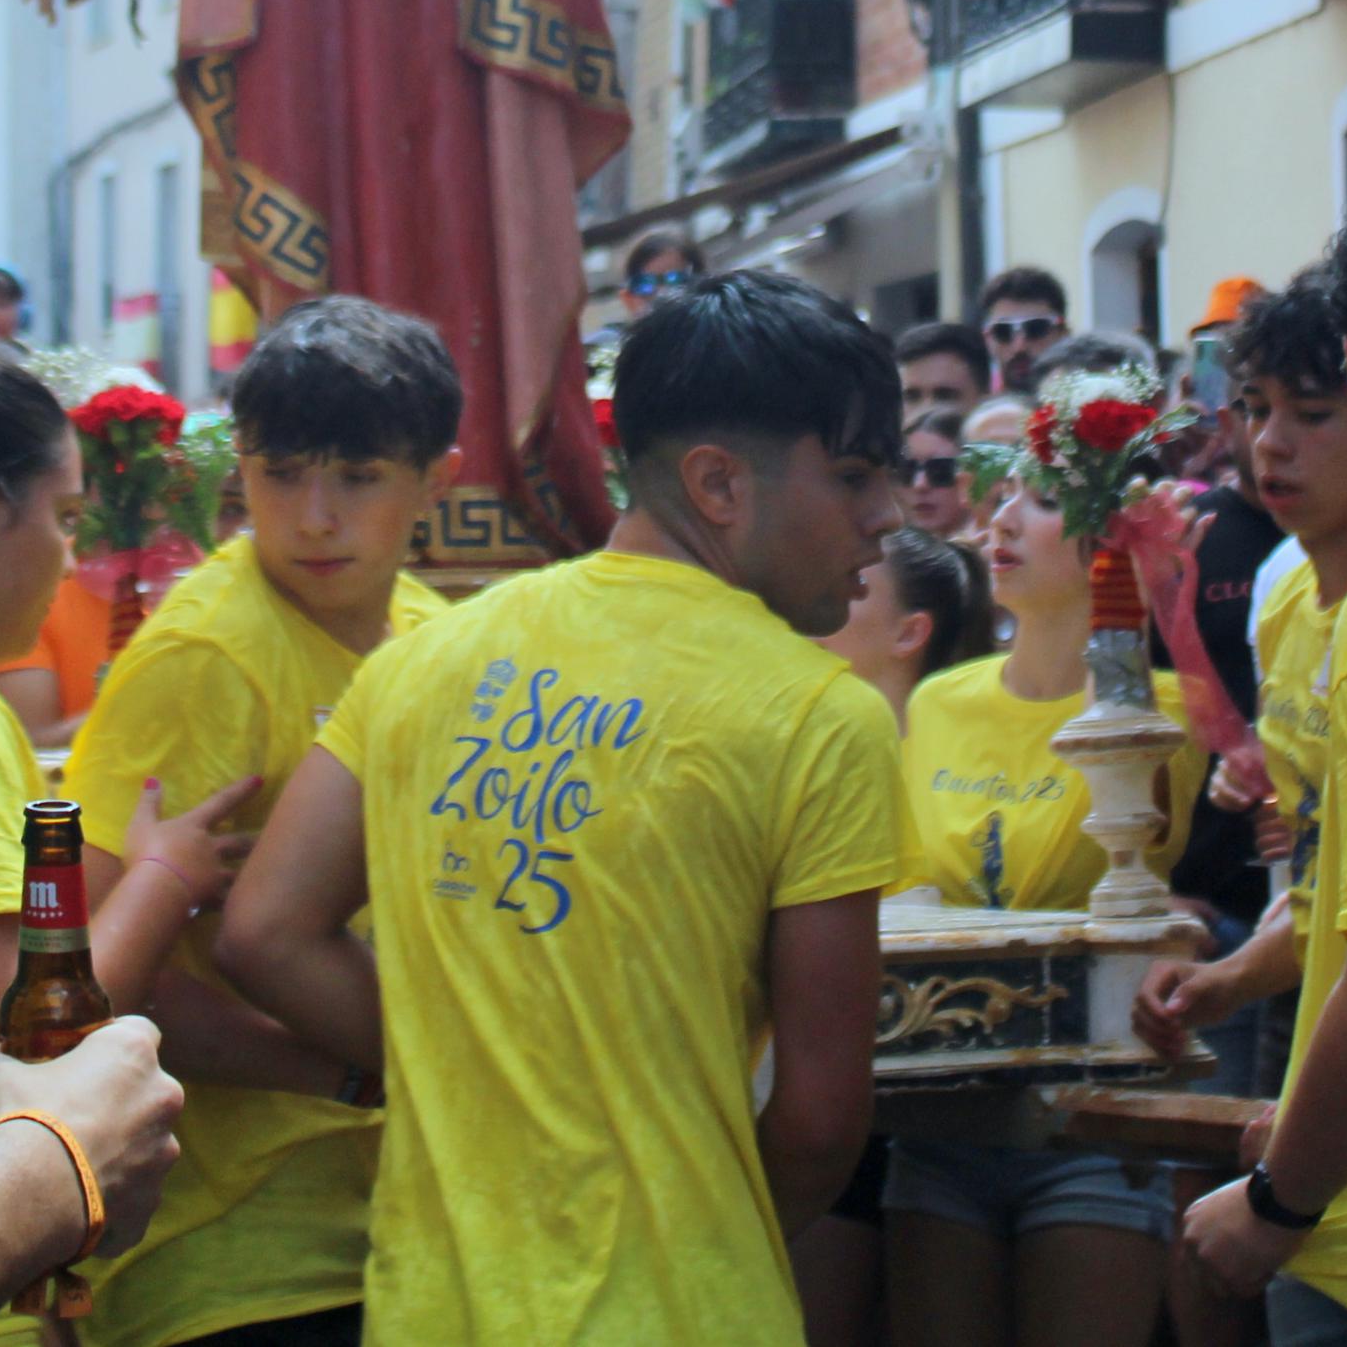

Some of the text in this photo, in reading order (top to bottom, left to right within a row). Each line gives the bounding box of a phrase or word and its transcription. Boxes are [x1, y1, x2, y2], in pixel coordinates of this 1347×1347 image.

[500, 668, 649, 754] San
[429, 735, 606, 844] Zoilo
[493, 838, 574, 935] 25
